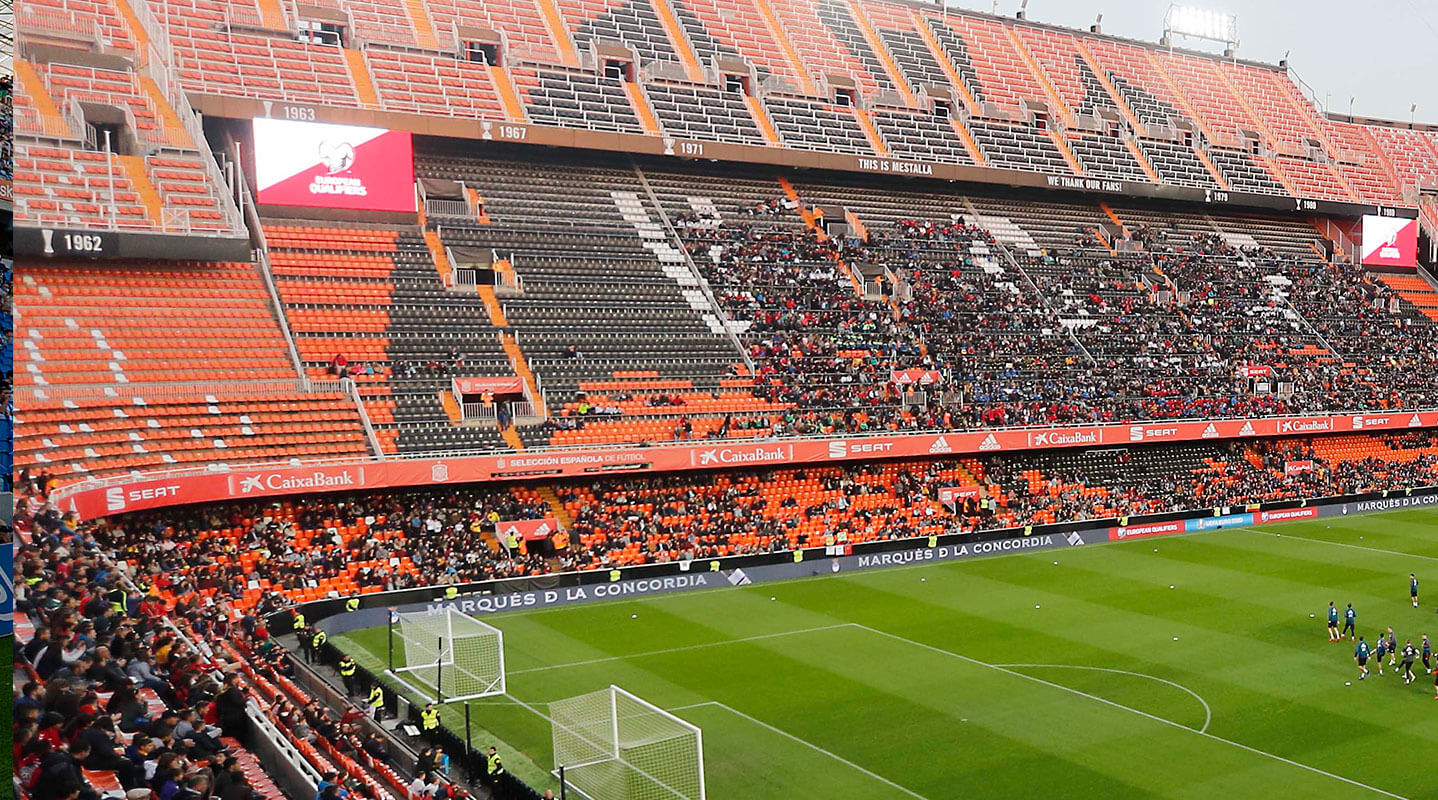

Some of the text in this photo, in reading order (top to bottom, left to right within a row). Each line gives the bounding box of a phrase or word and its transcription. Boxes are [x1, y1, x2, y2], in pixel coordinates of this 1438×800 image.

[284, 106, 316, 121] 1963
[499, 126, 527, 139] 1967
[681, 142, 703, 155] 1971
[858, 159, 933, 175] THIS IS MESTALLA
[1047, 176, 1122, 192] WE THANK OUR FANS!
[64, 234, 103, 252] 1962
[1293, 420, 1329, 431] CaixaBank
[1365, 417, 1390, 425] SEAT
[1049, 431, 1097, 445] CaixaBank
[1146, 428, 1178, 436] SEAT
[720, 448, 785, 463] CaixaBank
[850, 443, 894, 453] SEAT
[510, 456, 559, 467] SELECCIÓN
[560, 454, 603, 465] ESPAÑOLA
[616, 453, 646, 462] FÚTBOL
[266, 472, 354, 490] CaixaBank
[129, 485, 181, 502] SEAT
[1357, 498, 1400, 513] MARQUÉS
[1411, 497, 1420, 505] LA
[858, 548, 933, 569] MARQUÉS
[954, 545, 969, 556] LA
[974, 536, 1053, 554] CONCORDIA
[427, 591, 537, 617] MARQUÉS
[566, 587, 588, 601] LA
[594, 573, 708, 597] CONCORDIA
